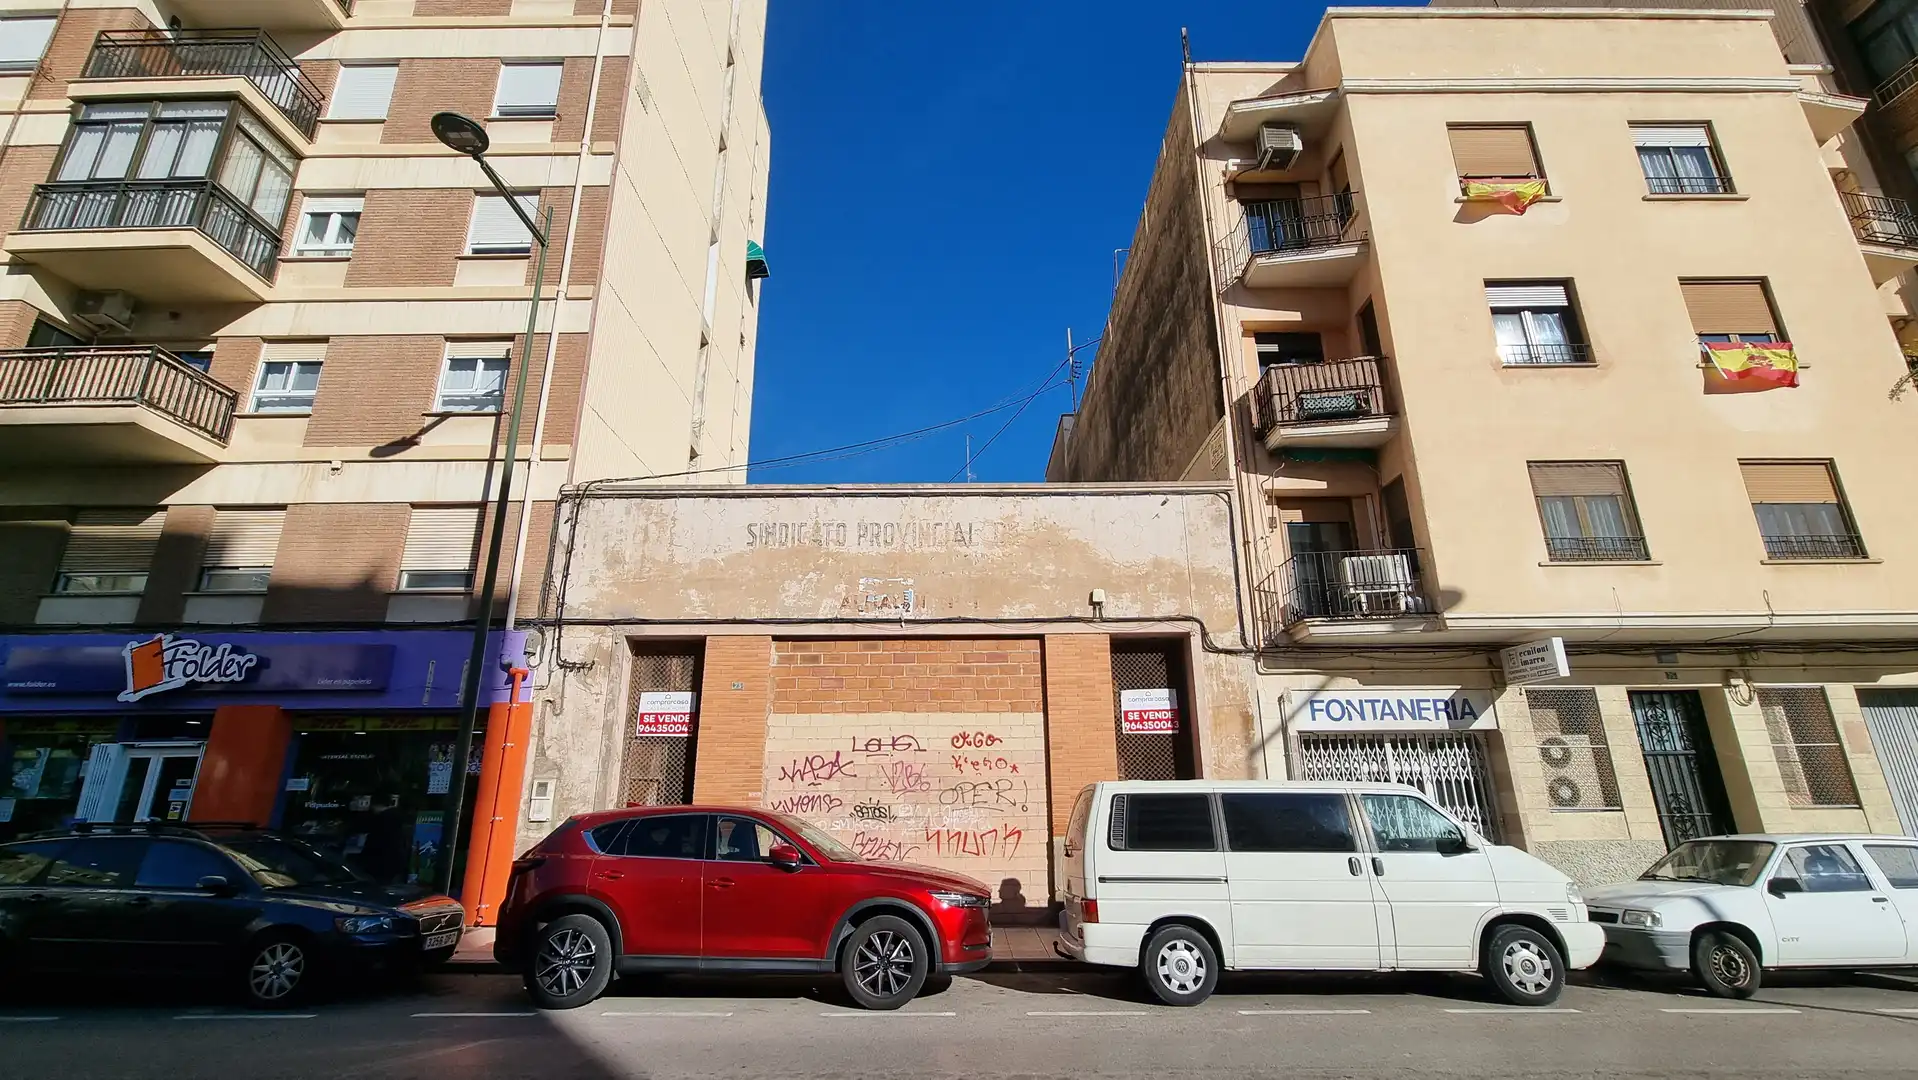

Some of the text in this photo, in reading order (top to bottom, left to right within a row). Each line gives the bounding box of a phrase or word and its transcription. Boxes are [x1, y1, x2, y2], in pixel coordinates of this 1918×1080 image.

[153, 641, 256, 681] Folder
[1309, 698, 1479, 723] FONTANERIA
[643, 714, 690, 723] SE VENDE
[1127, 711, 1175, 720] SE VENDE
[639, 724, 694, 733] 964350043
[1124, 720, 1179, 730] 964350043
